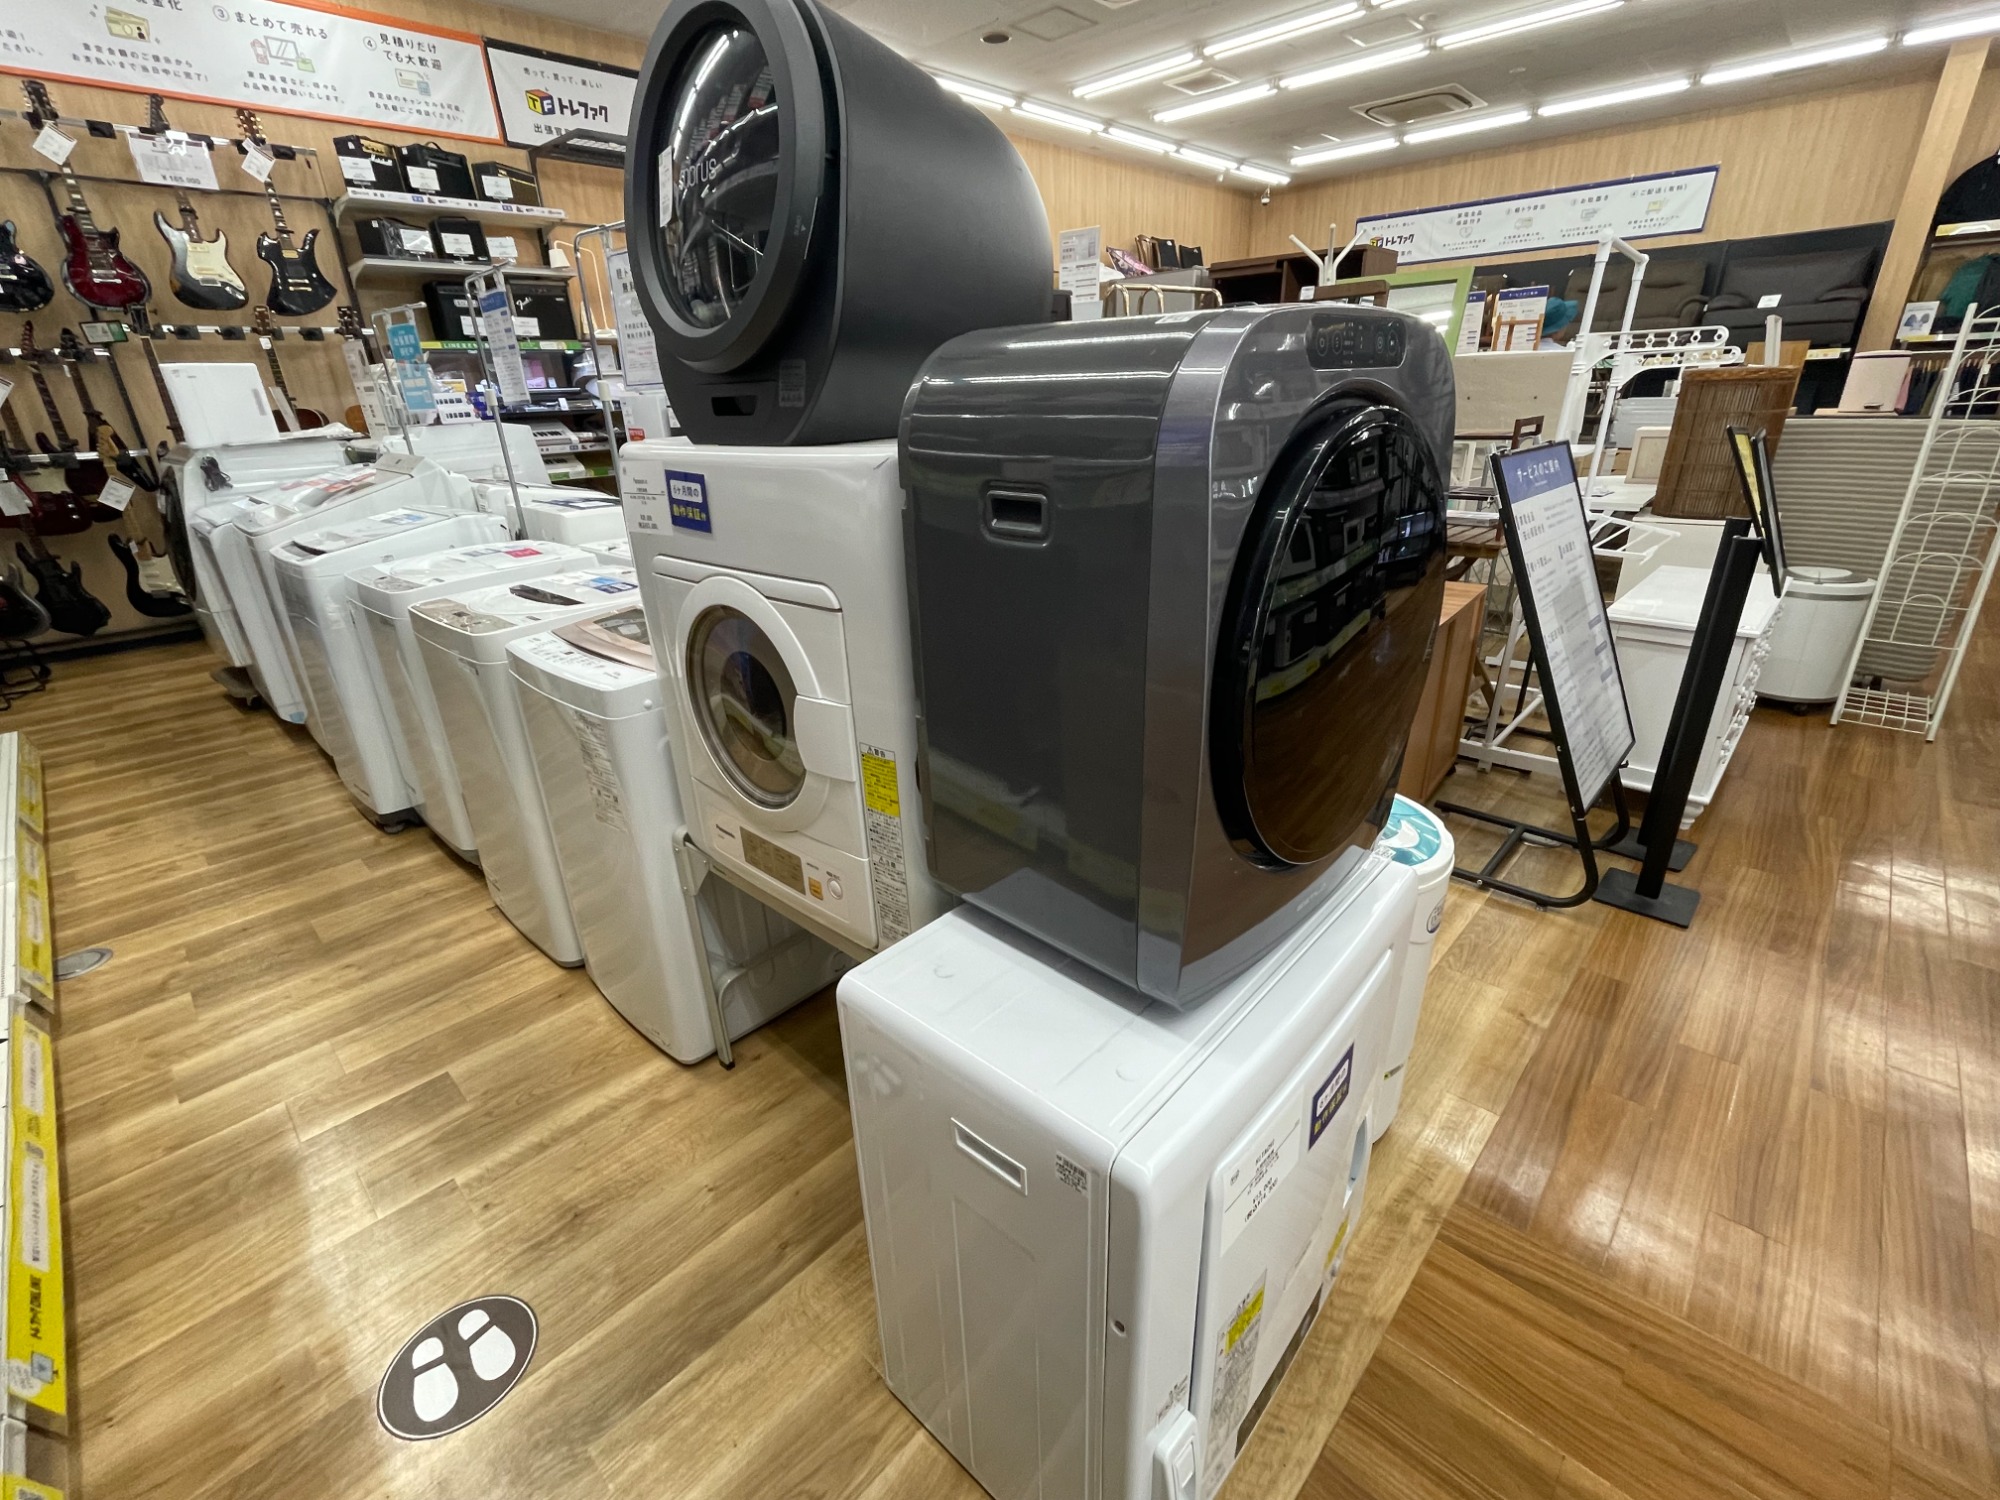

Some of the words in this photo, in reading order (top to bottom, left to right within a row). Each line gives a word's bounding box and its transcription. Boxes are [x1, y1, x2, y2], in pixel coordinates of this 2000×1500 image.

[136, 0, 183, 11] 金化
[234, 11, 328, 40] まとめて売れる
[379, 32, 438, 54] 見積りだけ
[382, 49, 442, 71] でも大歓迎
[557, 97, 609, 123] トレファク
